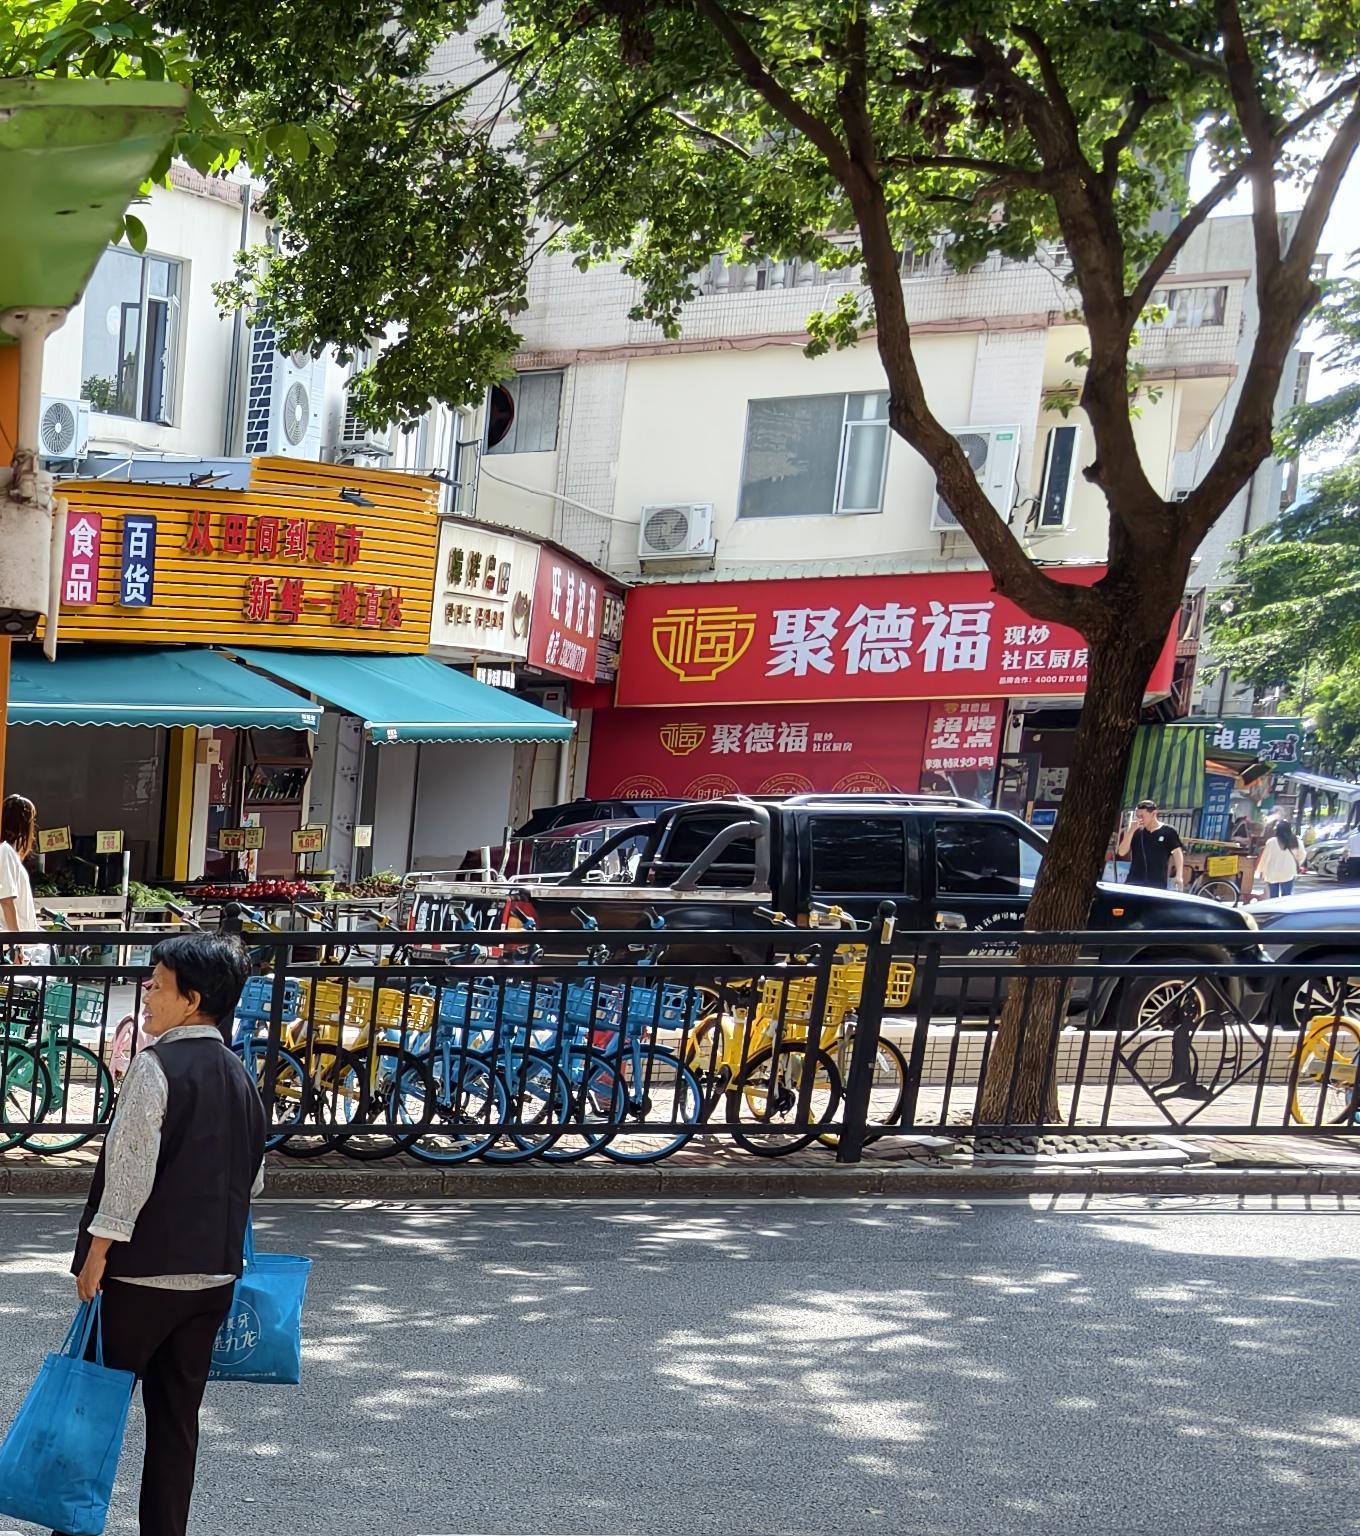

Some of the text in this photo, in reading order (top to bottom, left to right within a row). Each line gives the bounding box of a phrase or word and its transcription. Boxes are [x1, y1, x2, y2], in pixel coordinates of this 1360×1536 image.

[185, 509, 364, 566] 从田间到超市
[66, 517, 99, 602] 食品
[123, 521, 154, 604] 百货
[765, 600, 996, 679] 聚德福
[1003, 624, 1051, 646] 现炒
[1000, 649, 1089, 671] 社区厨房
[710, 721, 810, 755] 聚德福
[933, 715, 997, 733] 招牌
[930, 732, 993, 749] 必点
[1212, 727, 1261, 750] 电器
